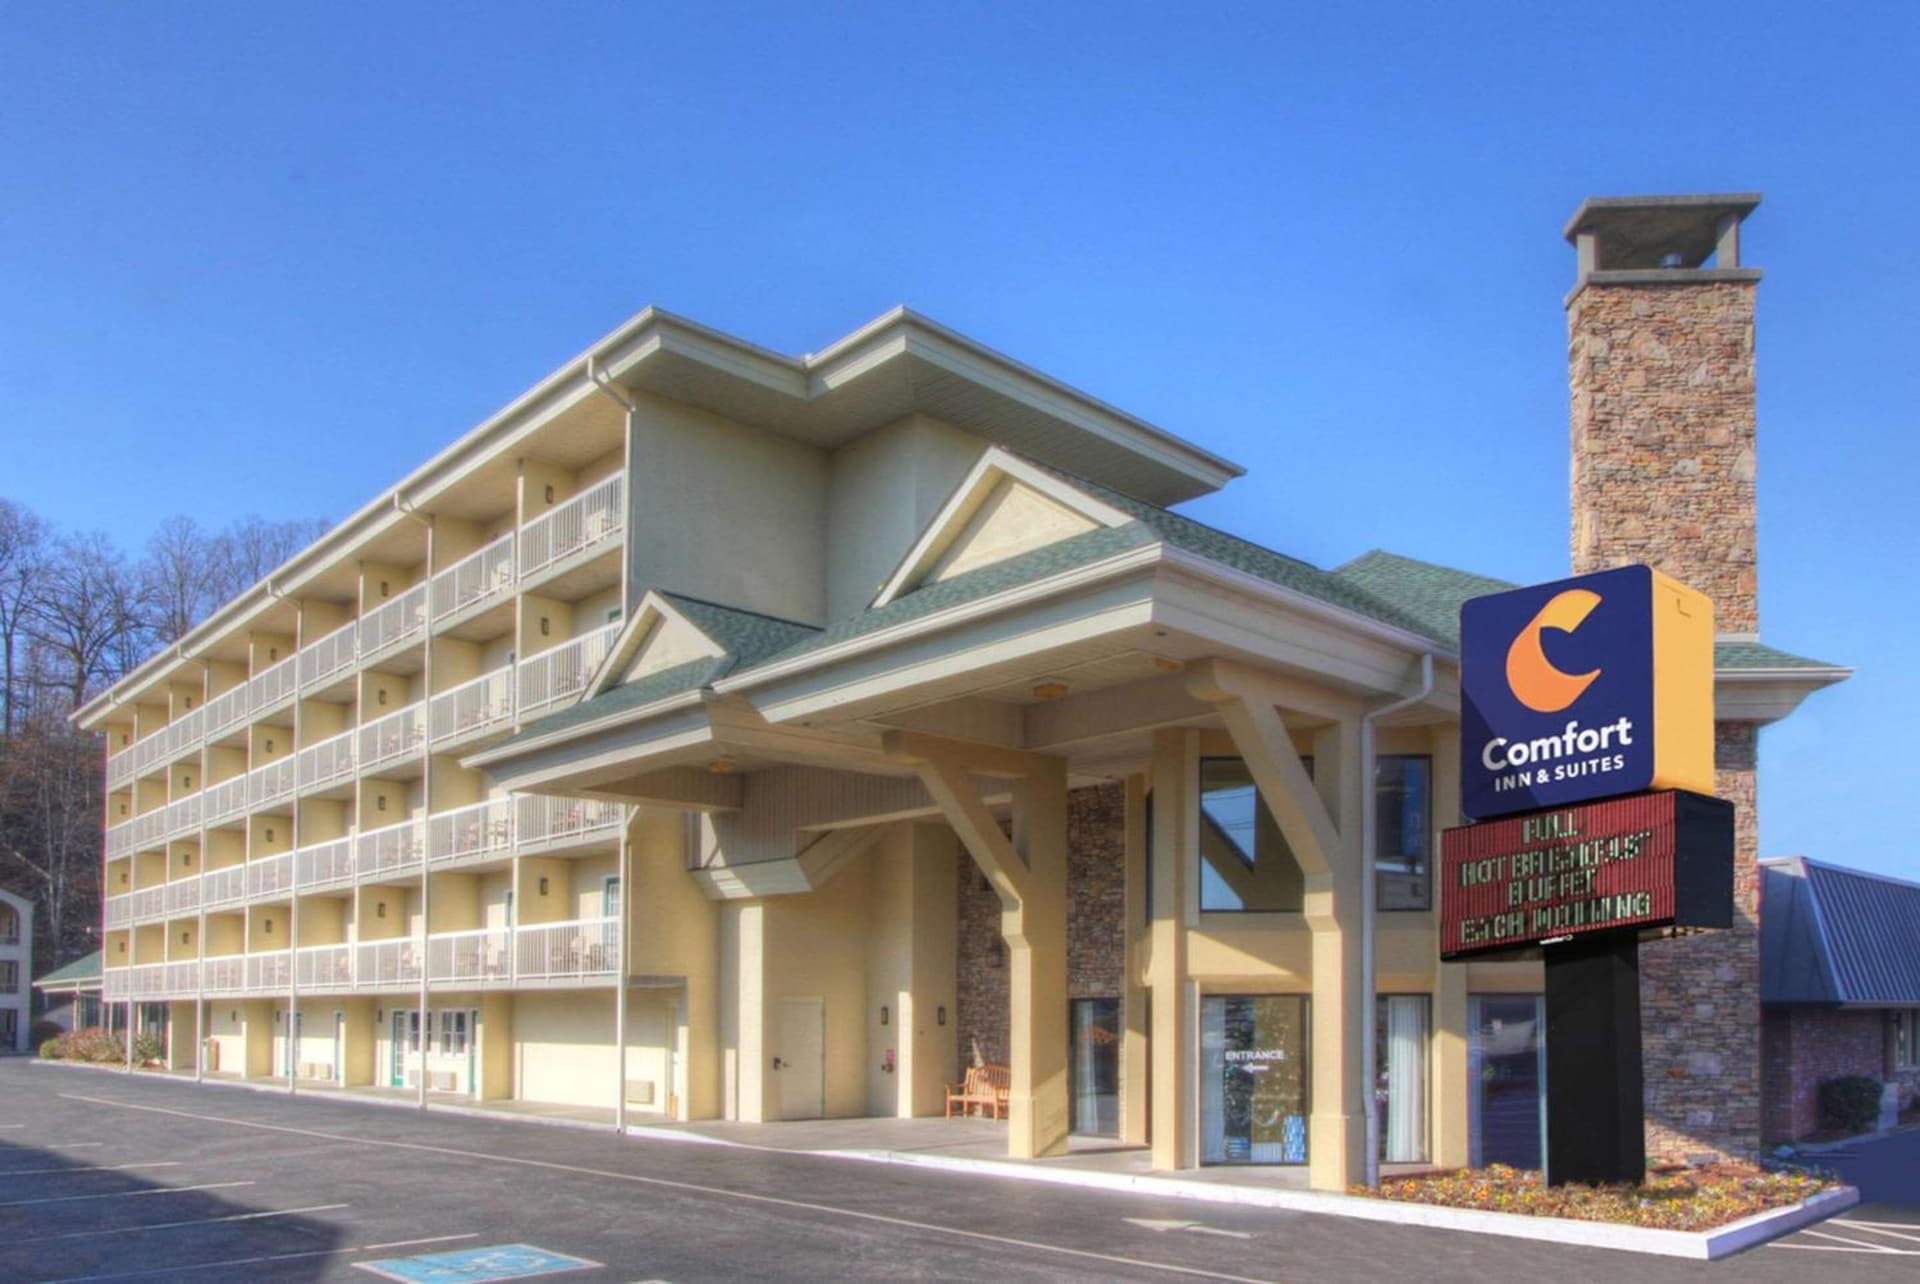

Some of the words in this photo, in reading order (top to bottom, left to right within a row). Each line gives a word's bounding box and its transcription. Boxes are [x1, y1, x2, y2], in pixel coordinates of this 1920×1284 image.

[1482, 716, 1633, 771] Comfort
[1494, 772, 1532, 793] INN
[1536, 768, 1550, 784] &
[1554, 754, 1625, 781] SUITES
[1461, 856, 1507, 888] HOT
[1509, 869, 1596, 906] BUFFET
[1460, 911, 1525, 944] EACH
[1225, 1050, 1285, 1061] ENTRANCE
